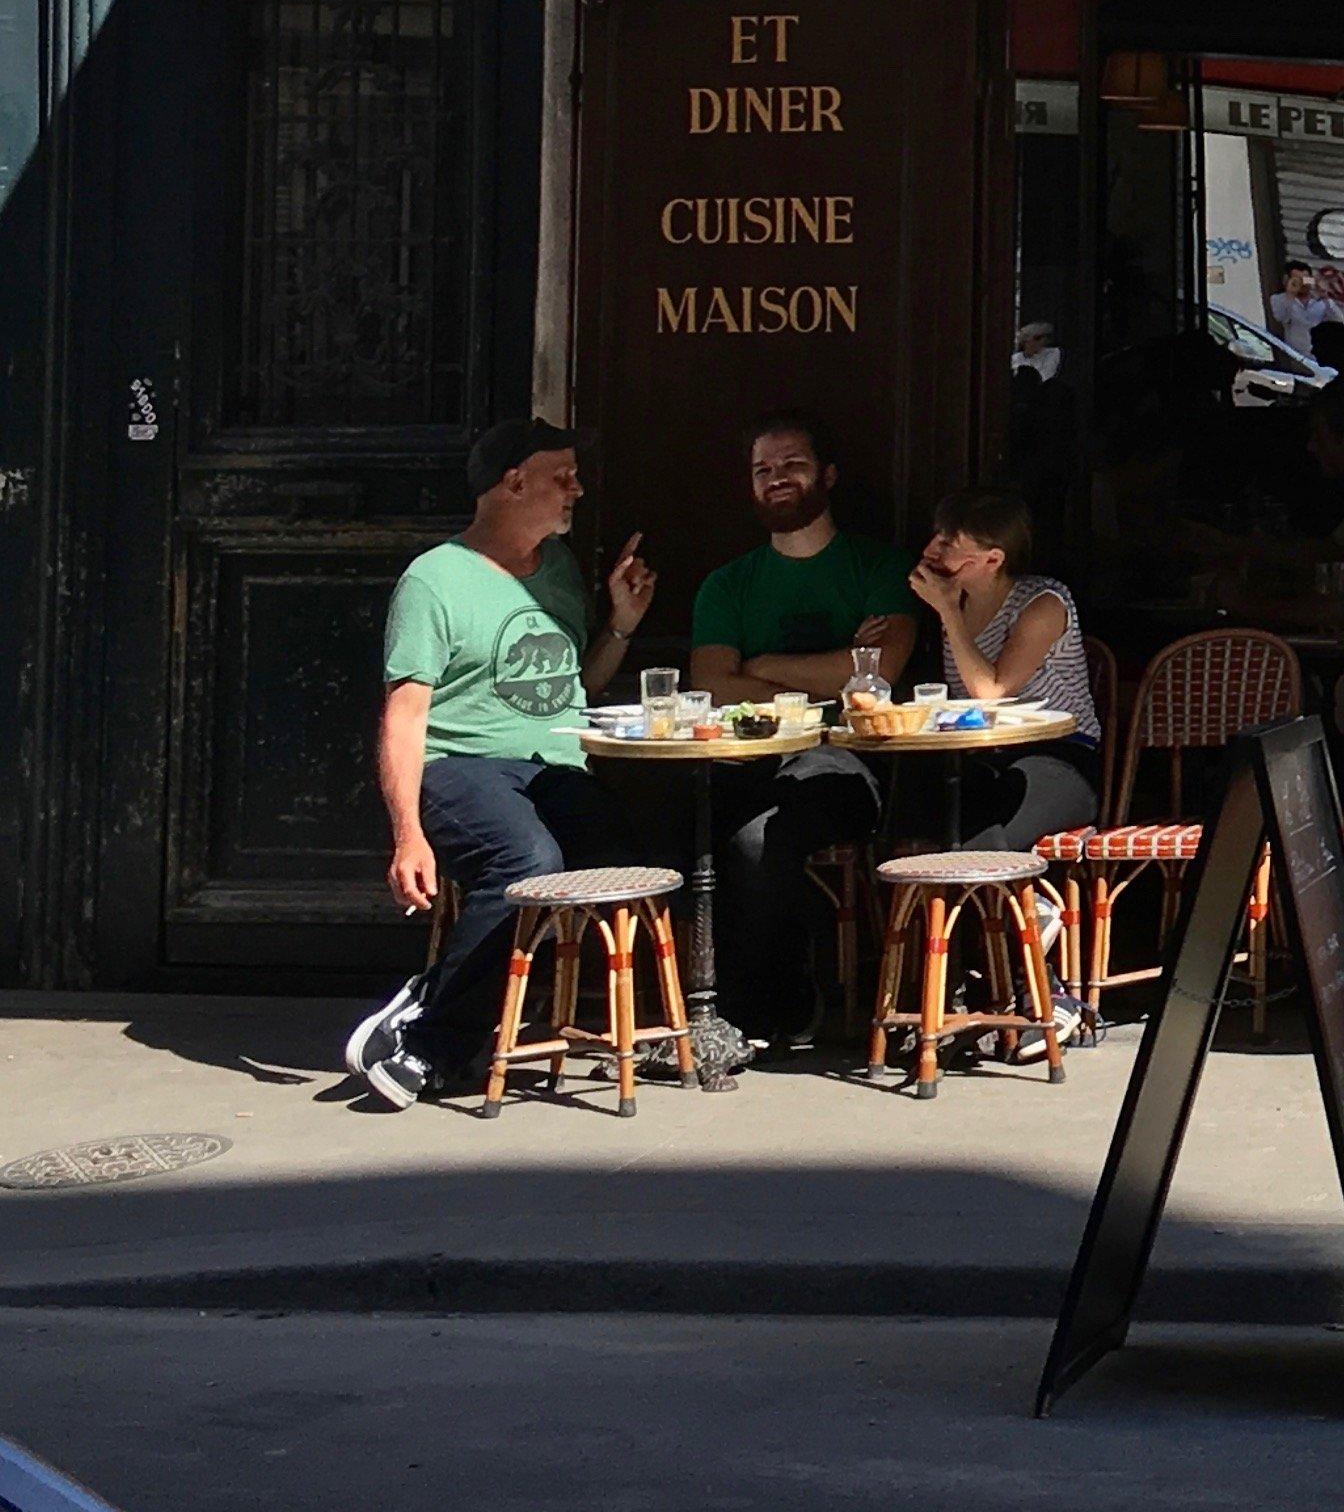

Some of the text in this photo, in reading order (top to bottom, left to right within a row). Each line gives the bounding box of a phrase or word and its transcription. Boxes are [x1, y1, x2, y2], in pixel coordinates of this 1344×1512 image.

[731, 16, 799, 64] ET
[689, 86, 844, 134] DINER
[1227, 100, 1270, 130] LE
[661, 196, 854, 245] CUISINE
[656, 286, 858, 334] MAISON
